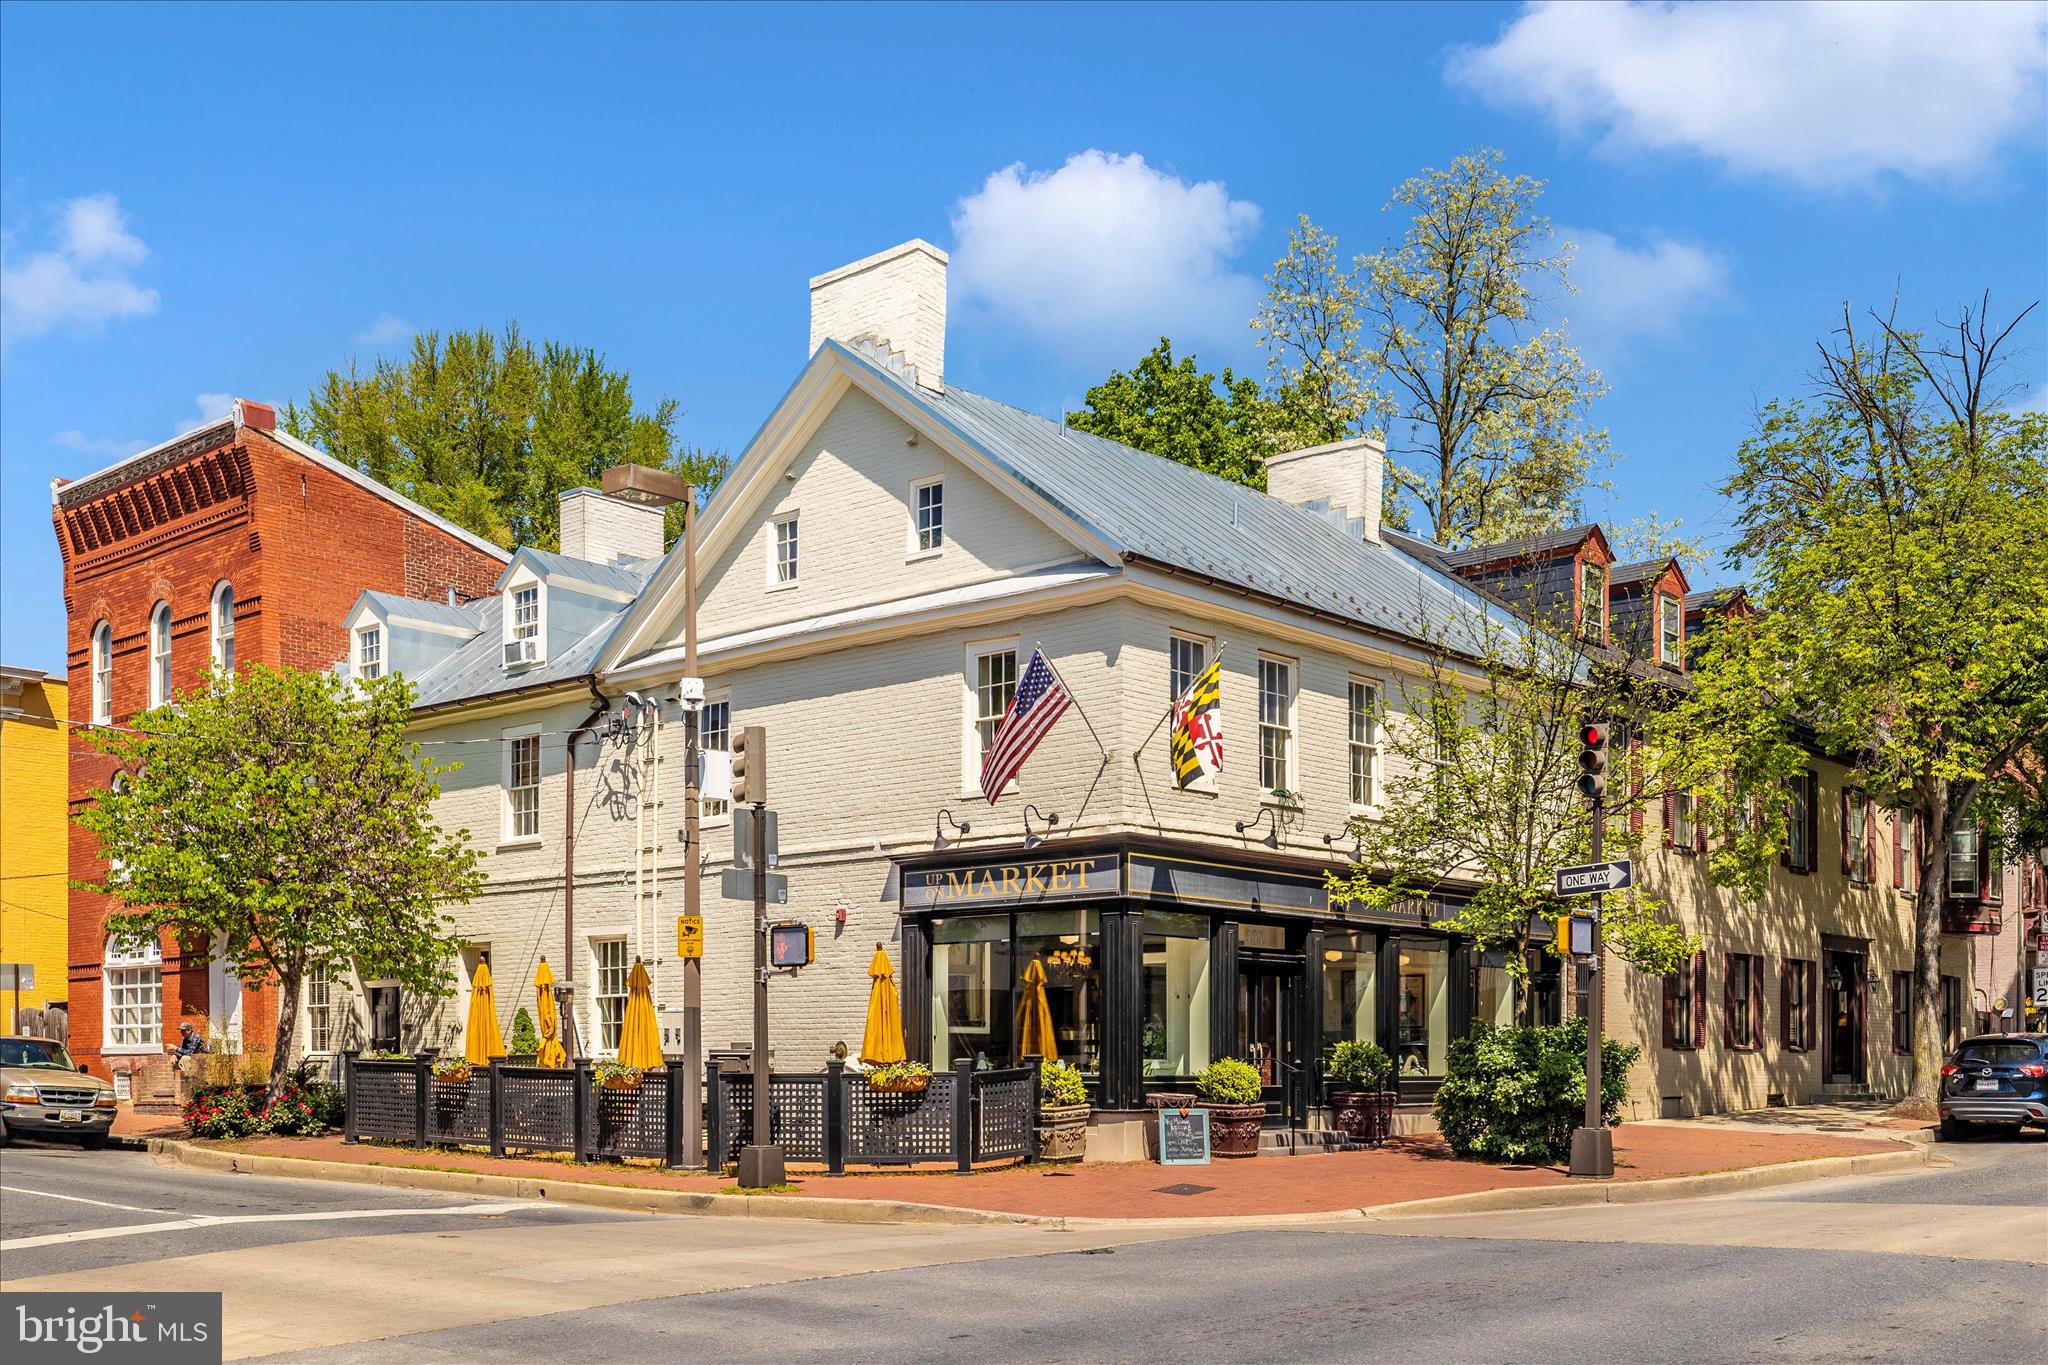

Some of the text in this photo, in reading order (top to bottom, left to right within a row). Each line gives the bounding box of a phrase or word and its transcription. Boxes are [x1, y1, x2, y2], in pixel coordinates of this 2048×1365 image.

[925, 873, 943, 886] UP
[946, 860, 1095, 899] MARKET
[1566, 871, 1610, 887] ONE WAY
[925, 887, 944, 900] ON
